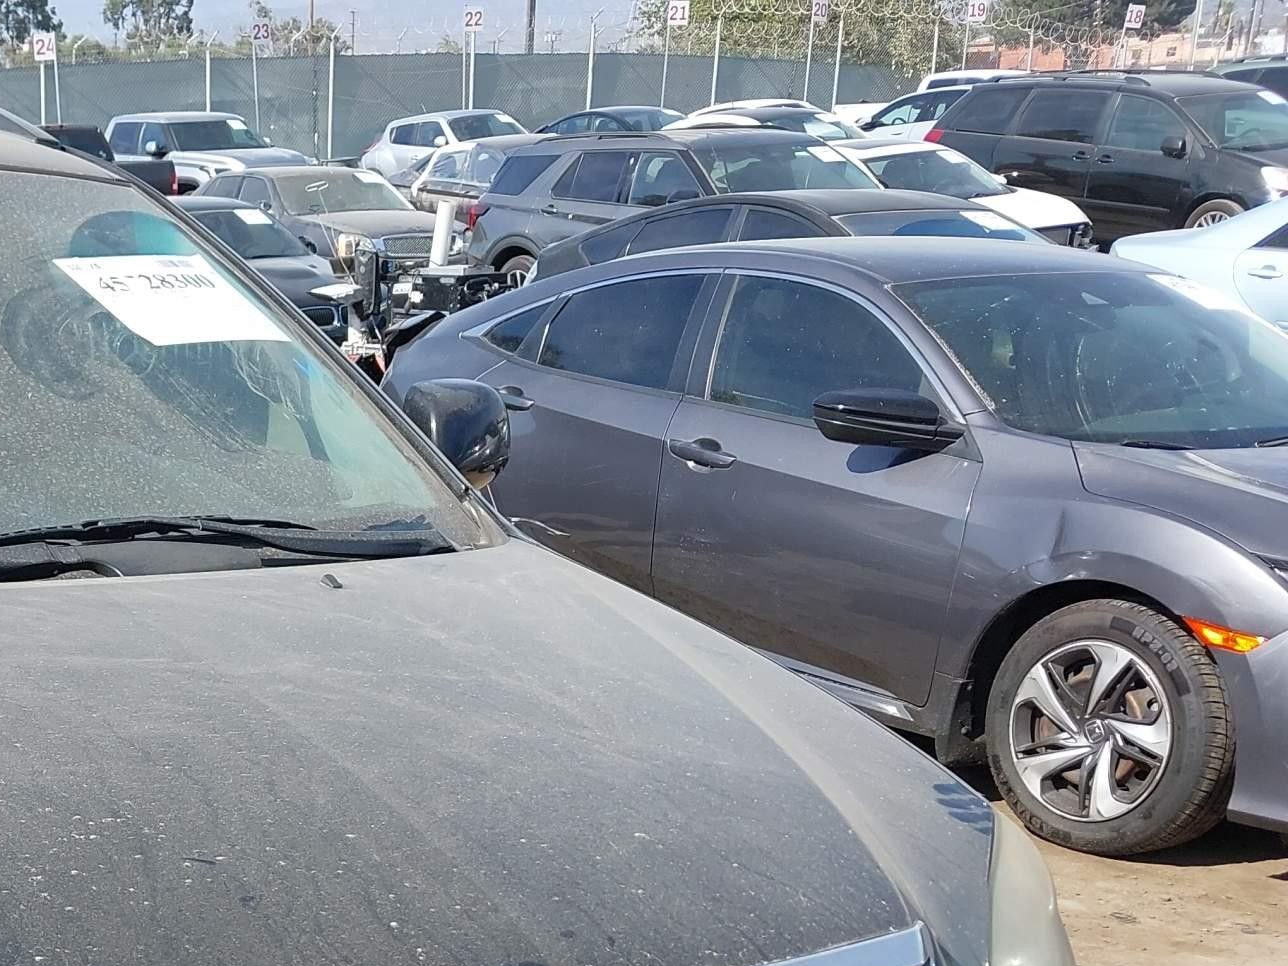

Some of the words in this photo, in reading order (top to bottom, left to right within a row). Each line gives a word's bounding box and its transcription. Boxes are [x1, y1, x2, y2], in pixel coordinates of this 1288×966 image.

[669, 5, 686, 20] 21
[814, 2, 827, 17] 20
[969, 3, 985, 17] 19
[1127, 10, 1143, 23] 18
[465, 11, 482, 27] 22
[253, 23, 269, 40] 23
[35, 38, 55, 56] 24
[99, 274, 215, 292] 4528300
